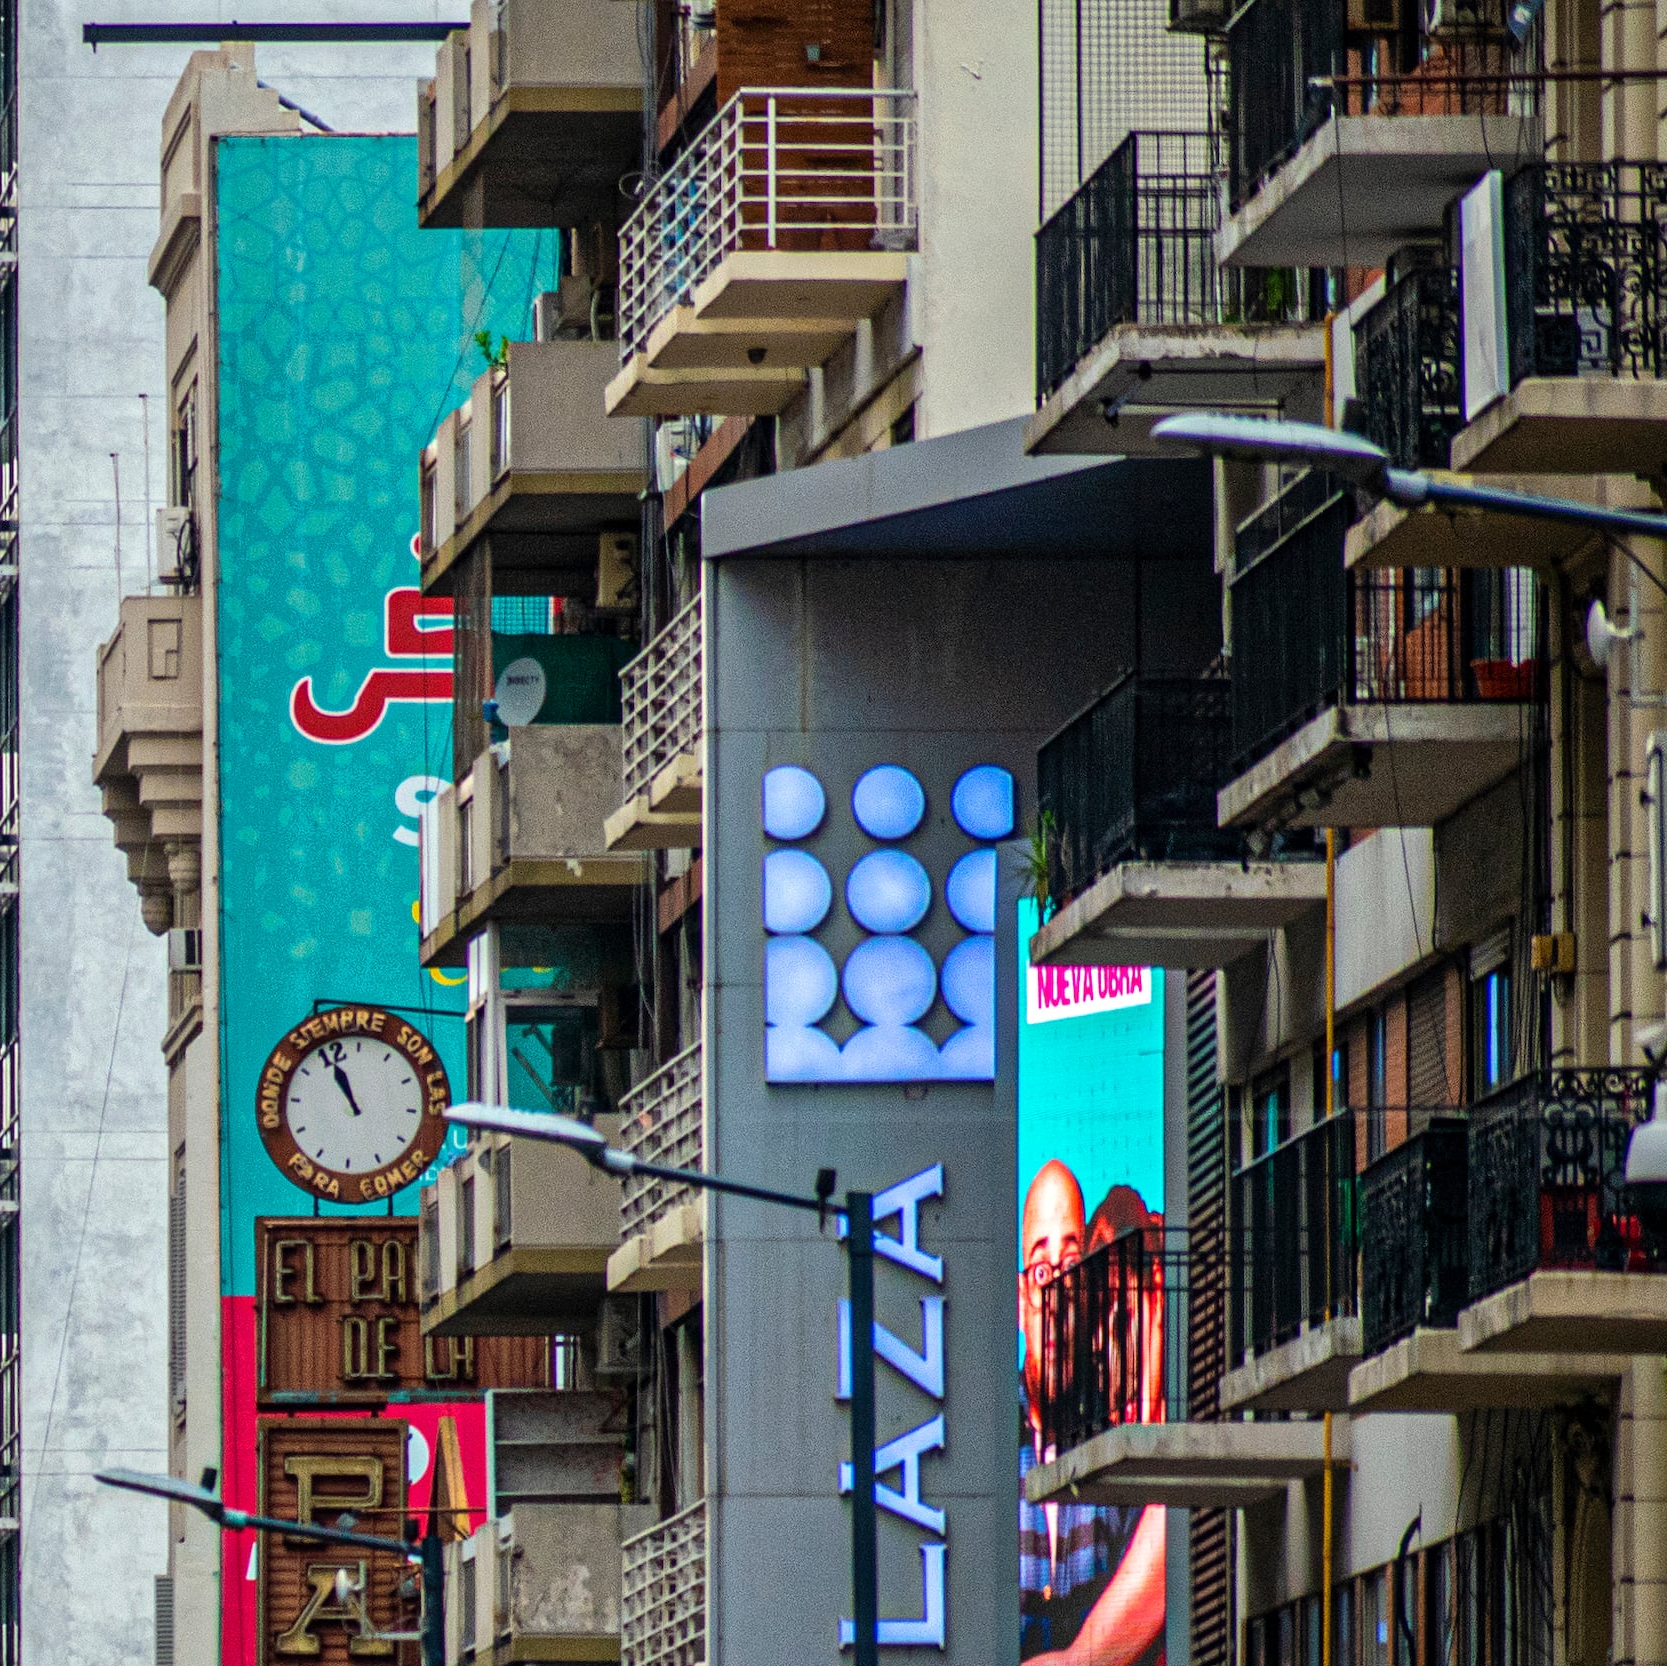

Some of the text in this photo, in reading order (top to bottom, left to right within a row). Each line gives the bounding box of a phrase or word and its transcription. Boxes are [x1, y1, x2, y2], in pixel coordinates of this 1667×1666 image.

[1037, 966, 1143, 1009] NUEVA OBRA
[262, 1009, 447, 1129] DONDE SIEMPRE SON LAS
[318, 1042, 347, 1068] 12
[289, 1150, 430, 1200] PARA COMER
[275, 1241, 322, 1305] EL
[342, 1317, 475, 1381] DE LA
